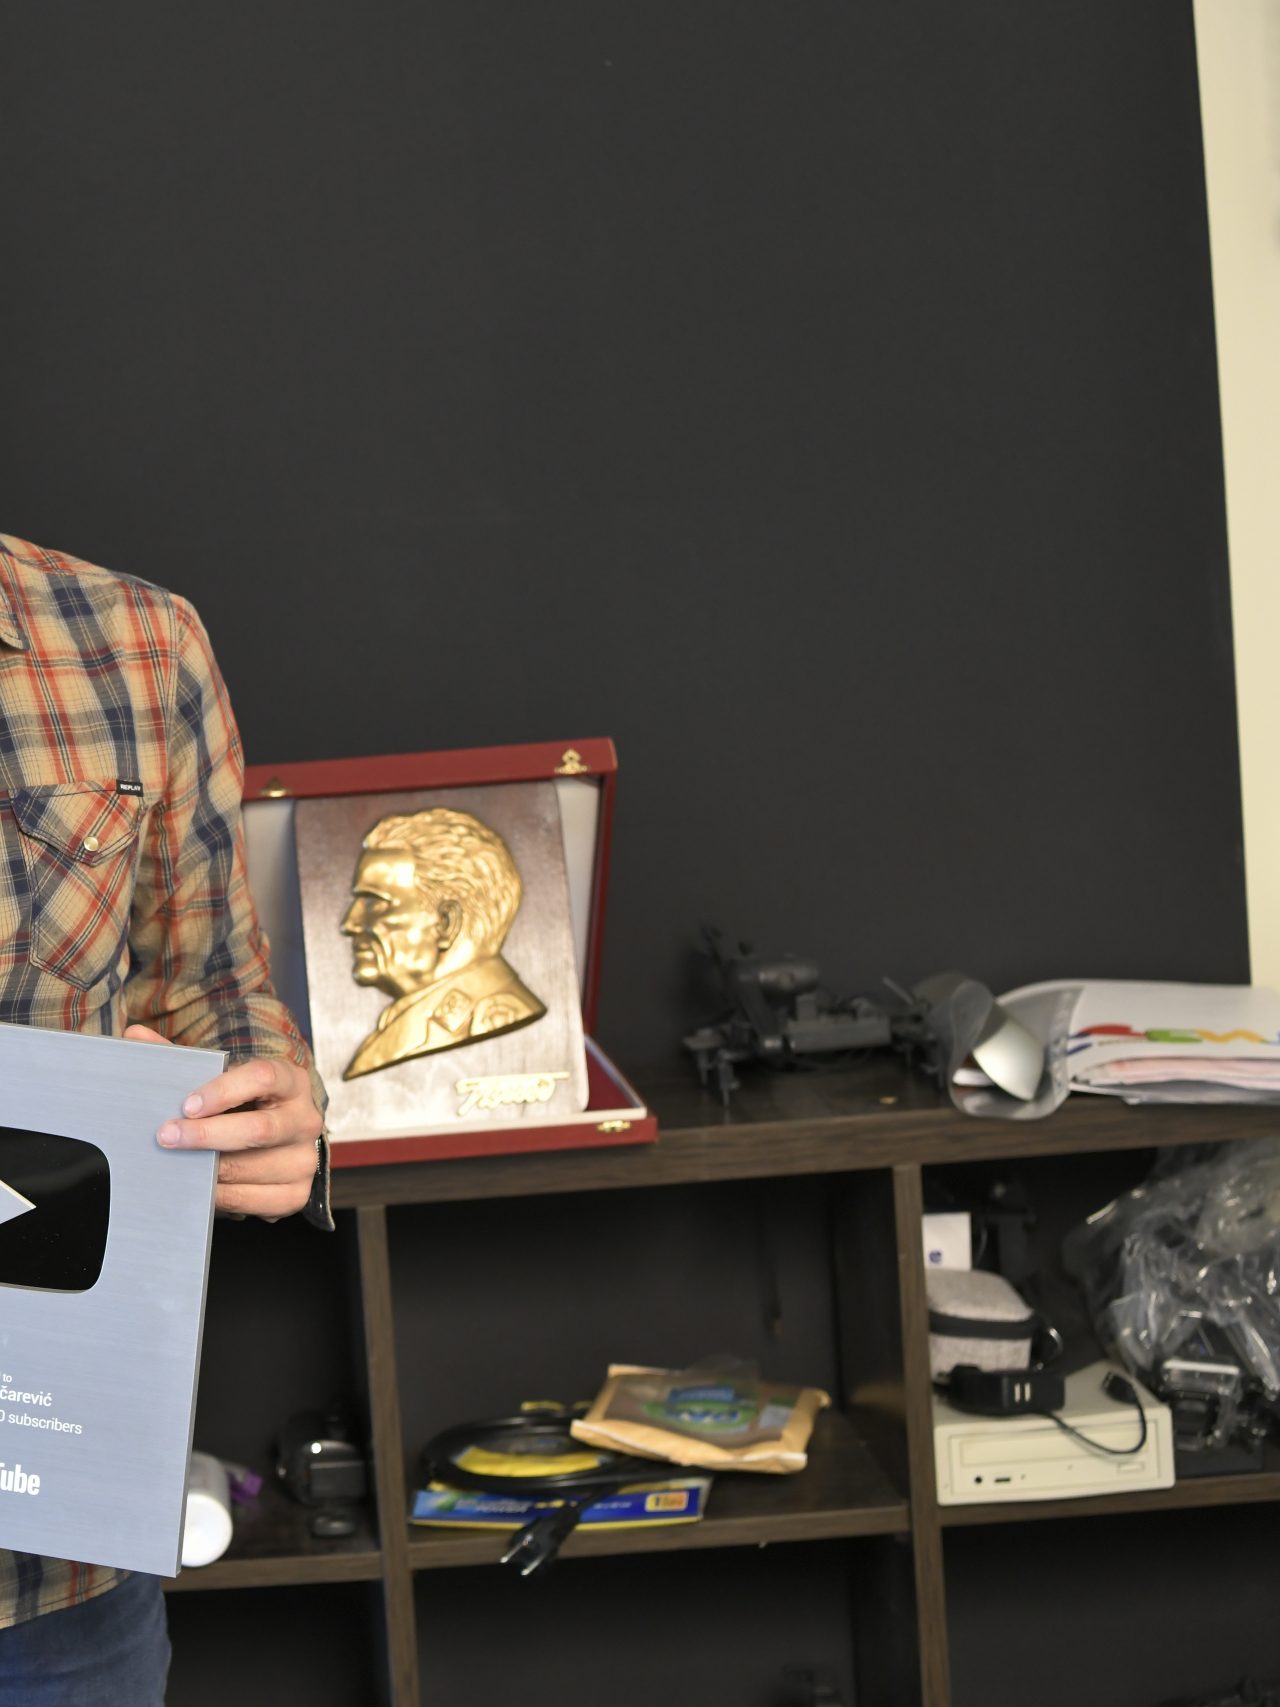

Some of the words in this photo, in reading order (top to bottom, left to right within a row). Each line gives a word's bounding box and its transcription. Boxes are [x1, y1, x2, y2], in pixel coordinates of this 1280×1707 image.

[120, 783, 141, 791] REPLAY
[2, 1373, 13, 1382] to
[7, 1412, 82, 1434] subscribers
